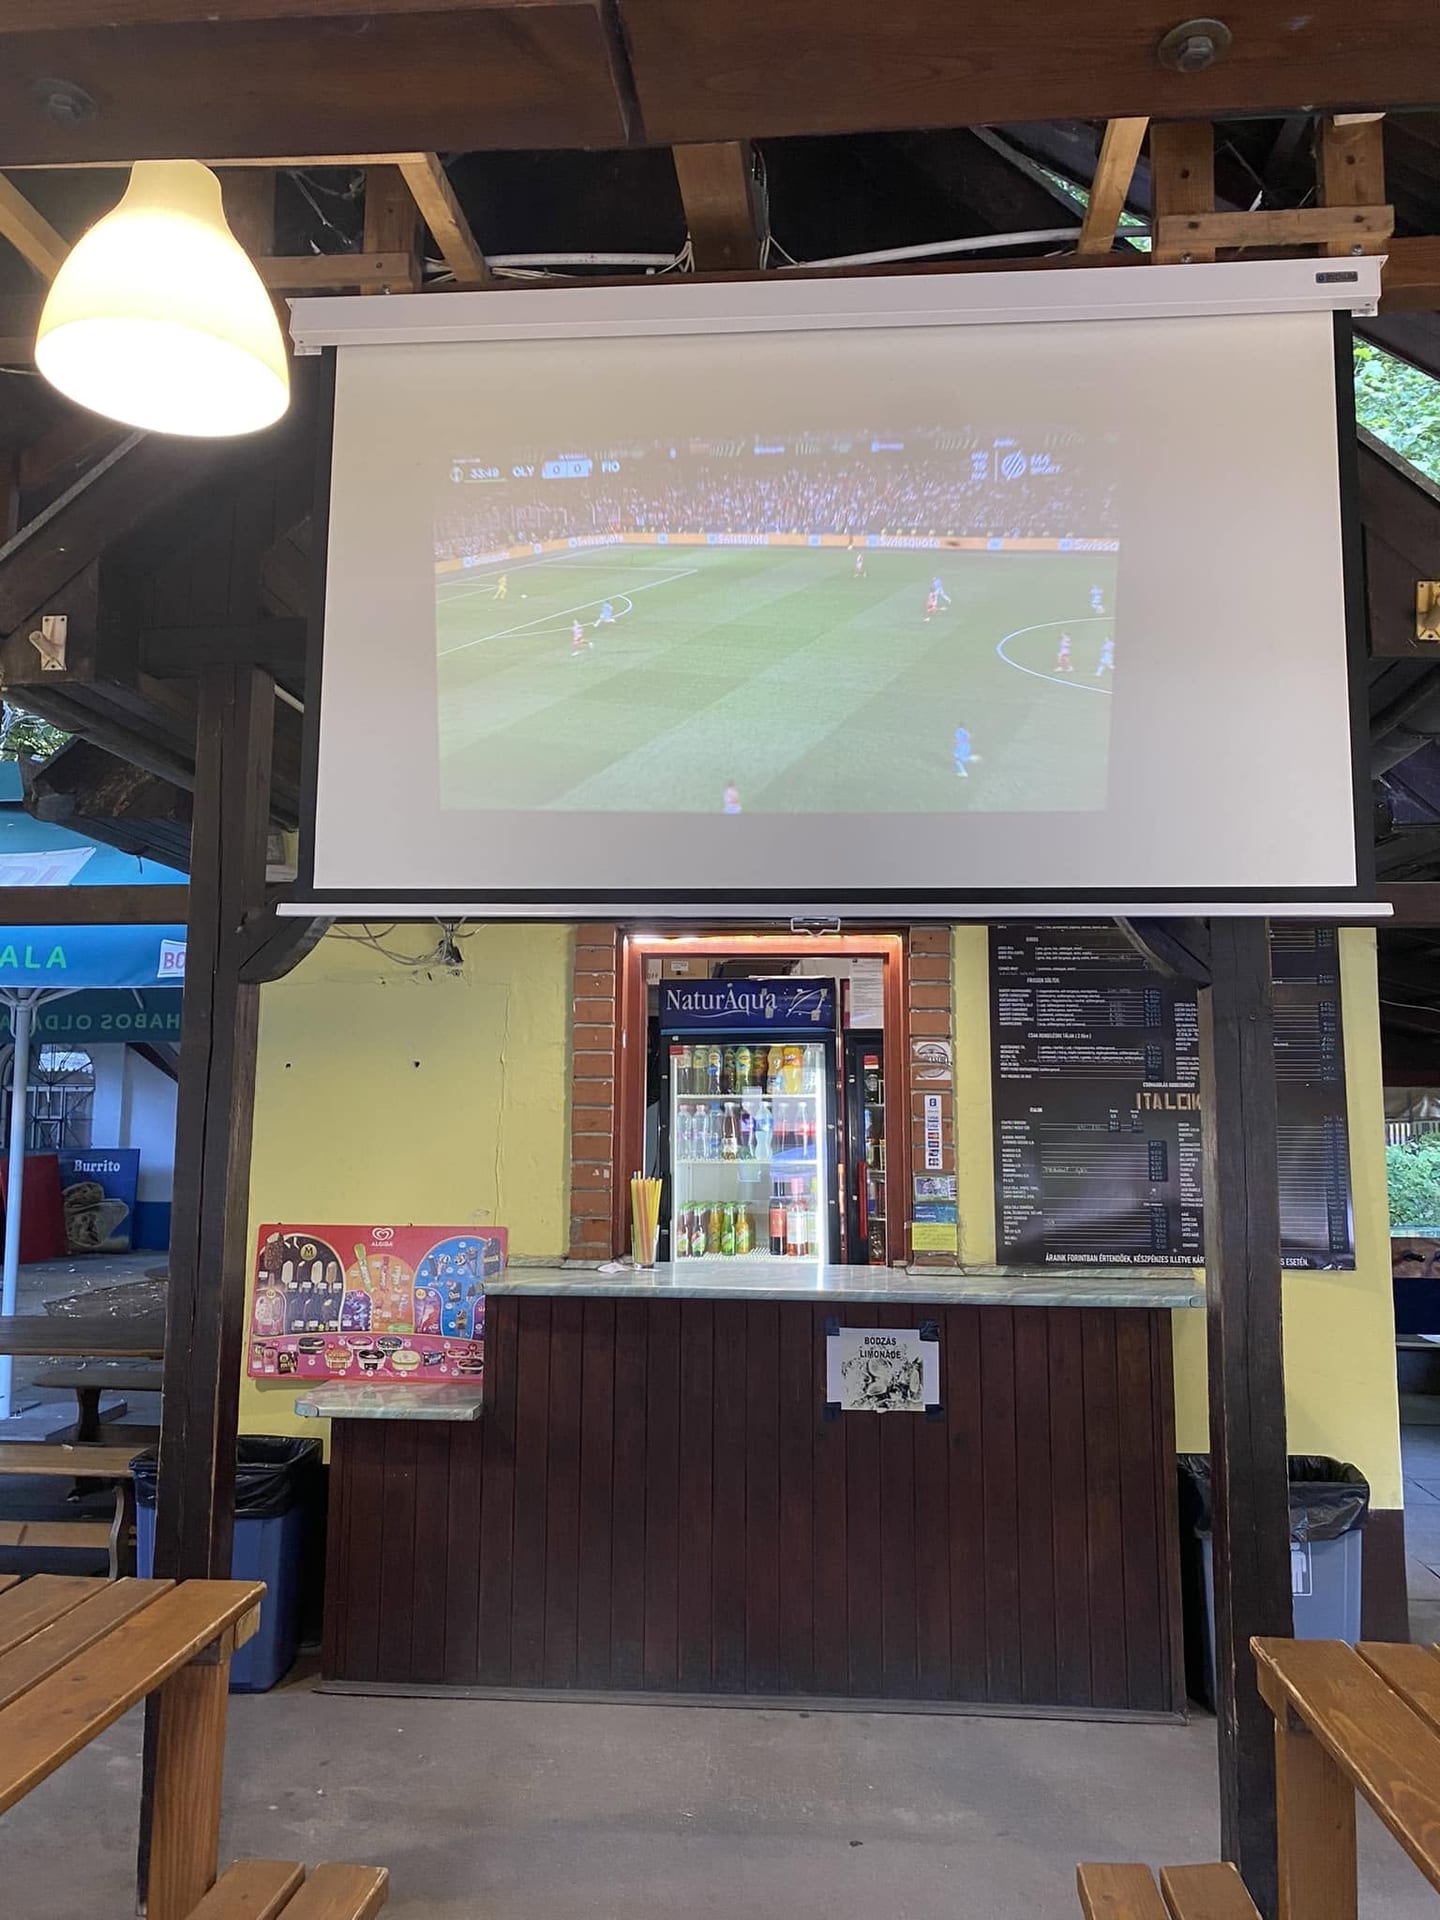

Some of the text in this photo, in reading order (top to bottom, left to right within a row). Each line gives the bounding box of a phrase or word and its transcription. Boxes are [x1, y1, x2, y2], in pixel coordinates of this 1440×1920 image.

[512, 465, 535, 479] OLY
[163, 951, 185, 970] BO
[73, 1159, 120, 1172] Burrito
